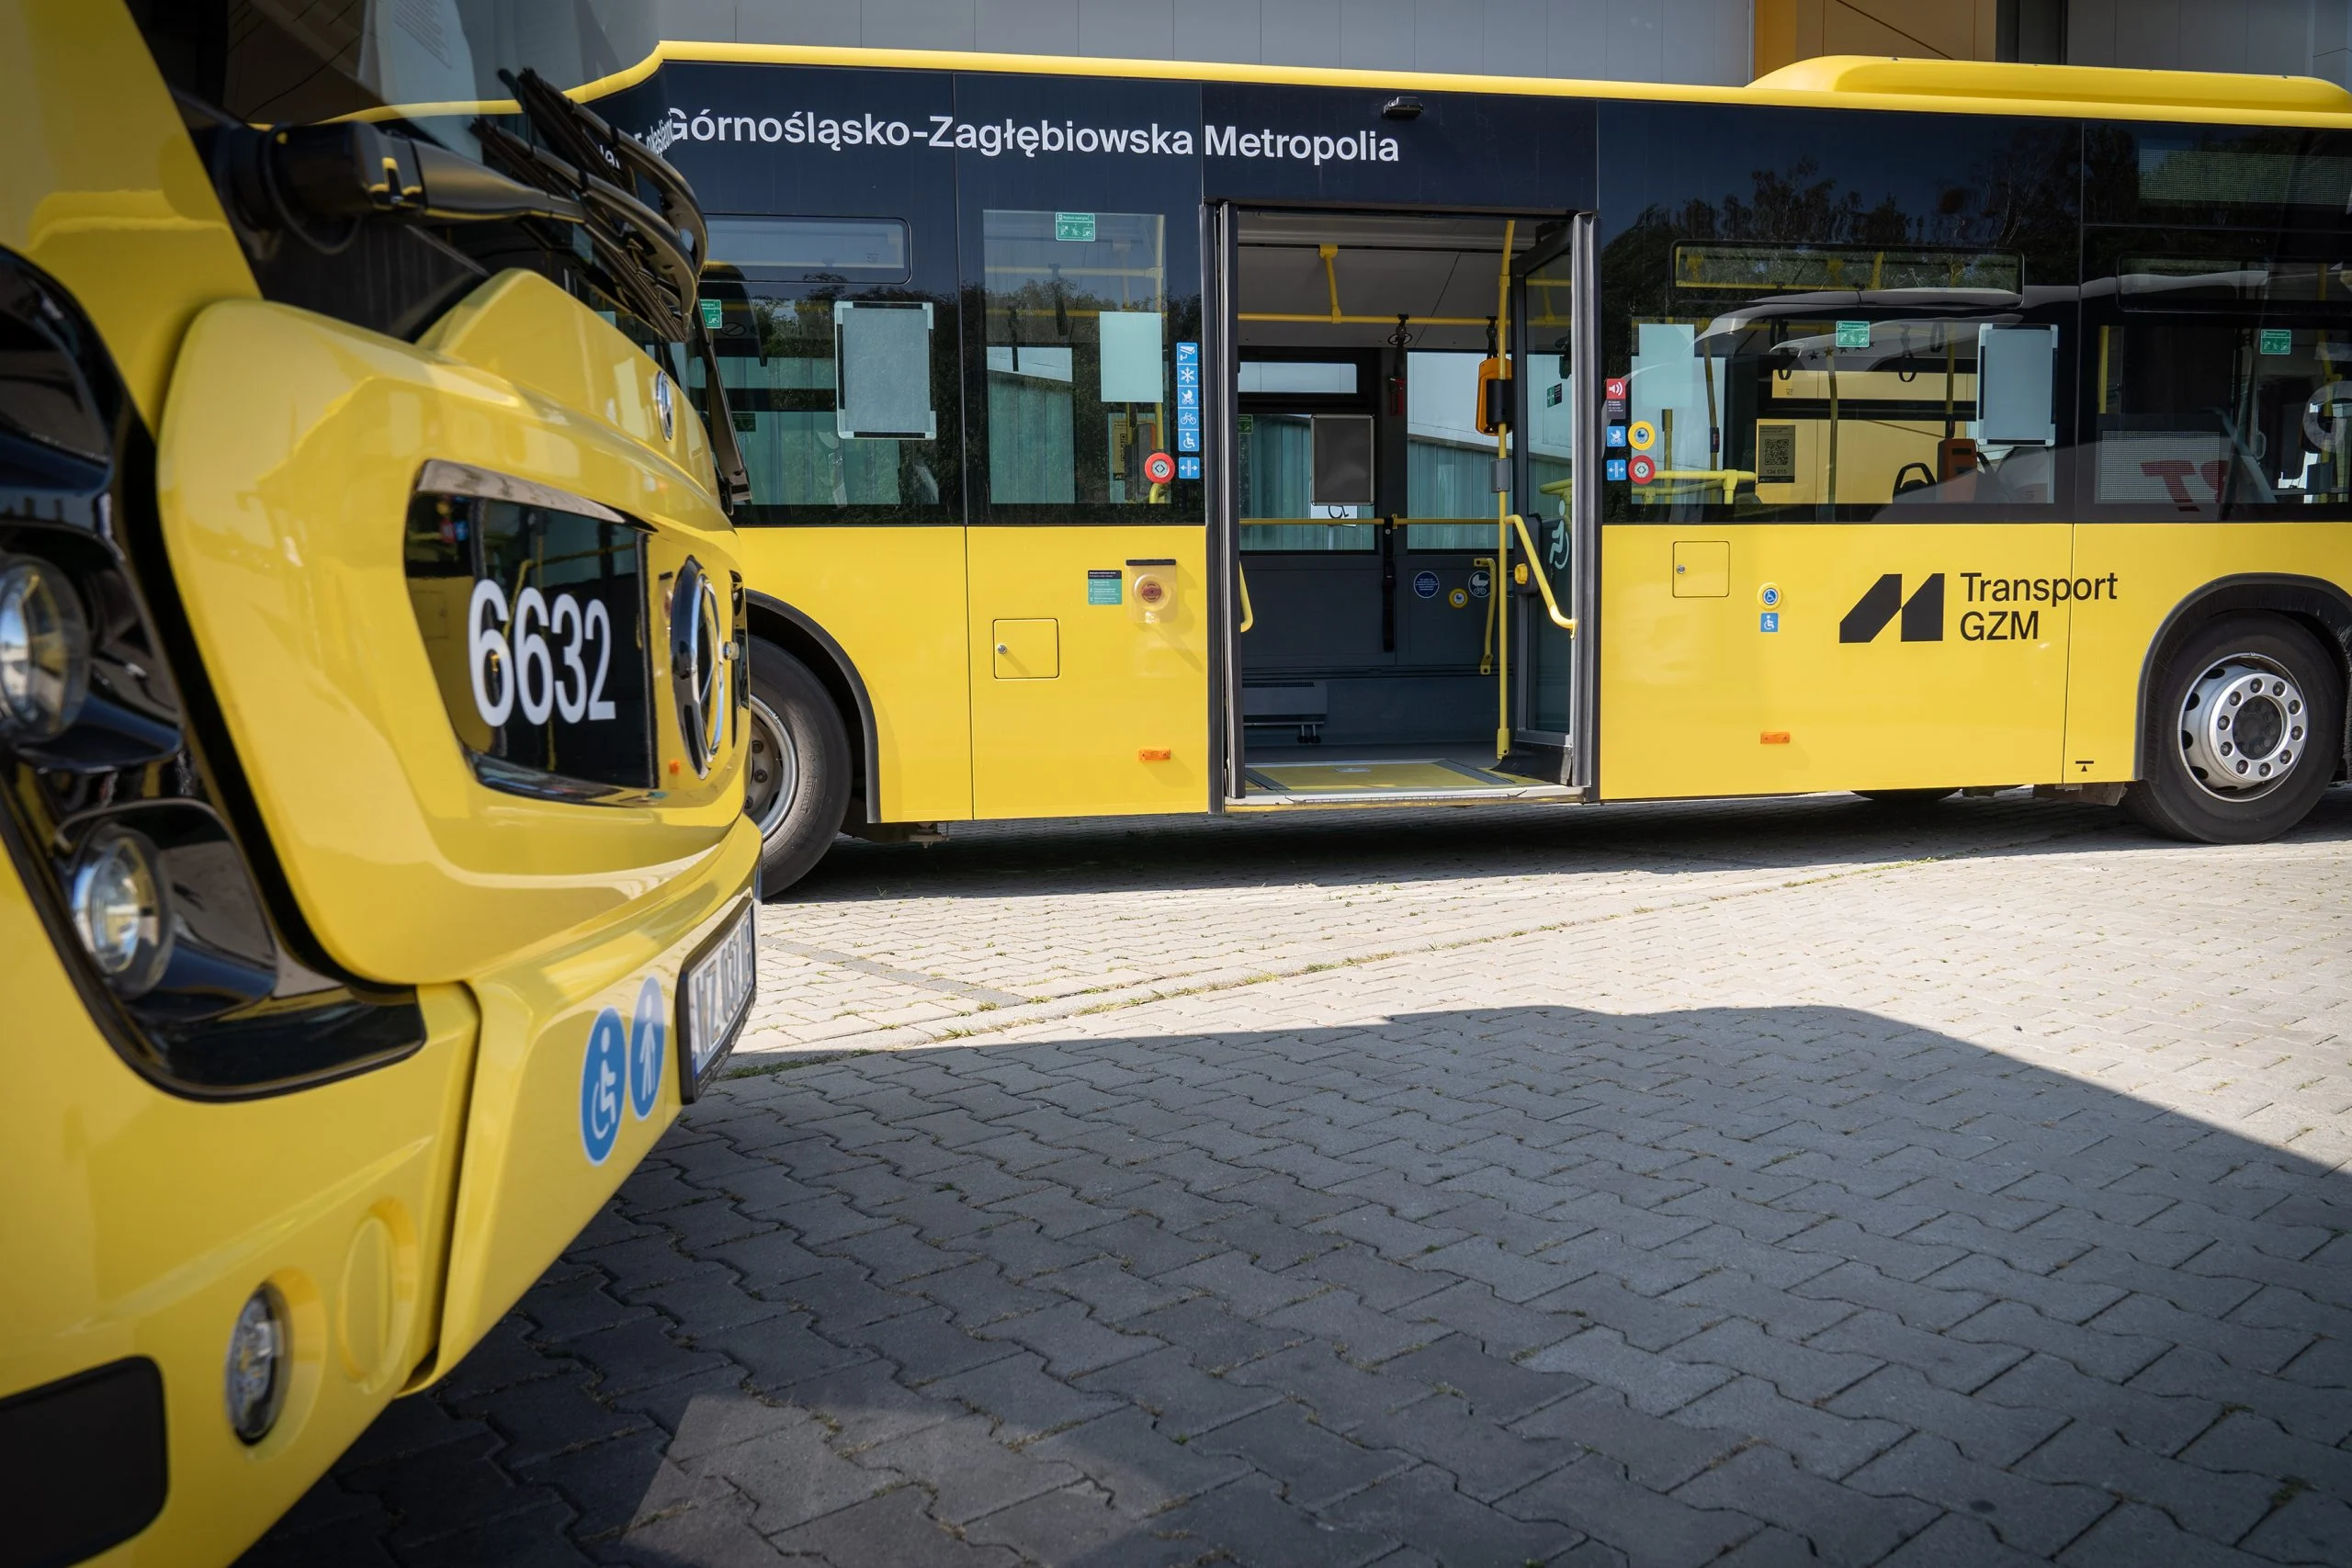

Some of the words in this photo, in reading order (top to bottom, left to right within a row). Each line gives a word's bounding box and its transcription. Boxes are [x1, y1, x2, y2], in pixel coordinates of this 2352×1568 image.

[669, 107, 1193, 158] Górnośląsko-Zagłębiowska
[1204, 125, 1399, 166] Metropolia
[1960, 572, 2119, 607] Transport
[1960, 610, 2039, 641] GZM
[469, 579, 616, 727] 6632
